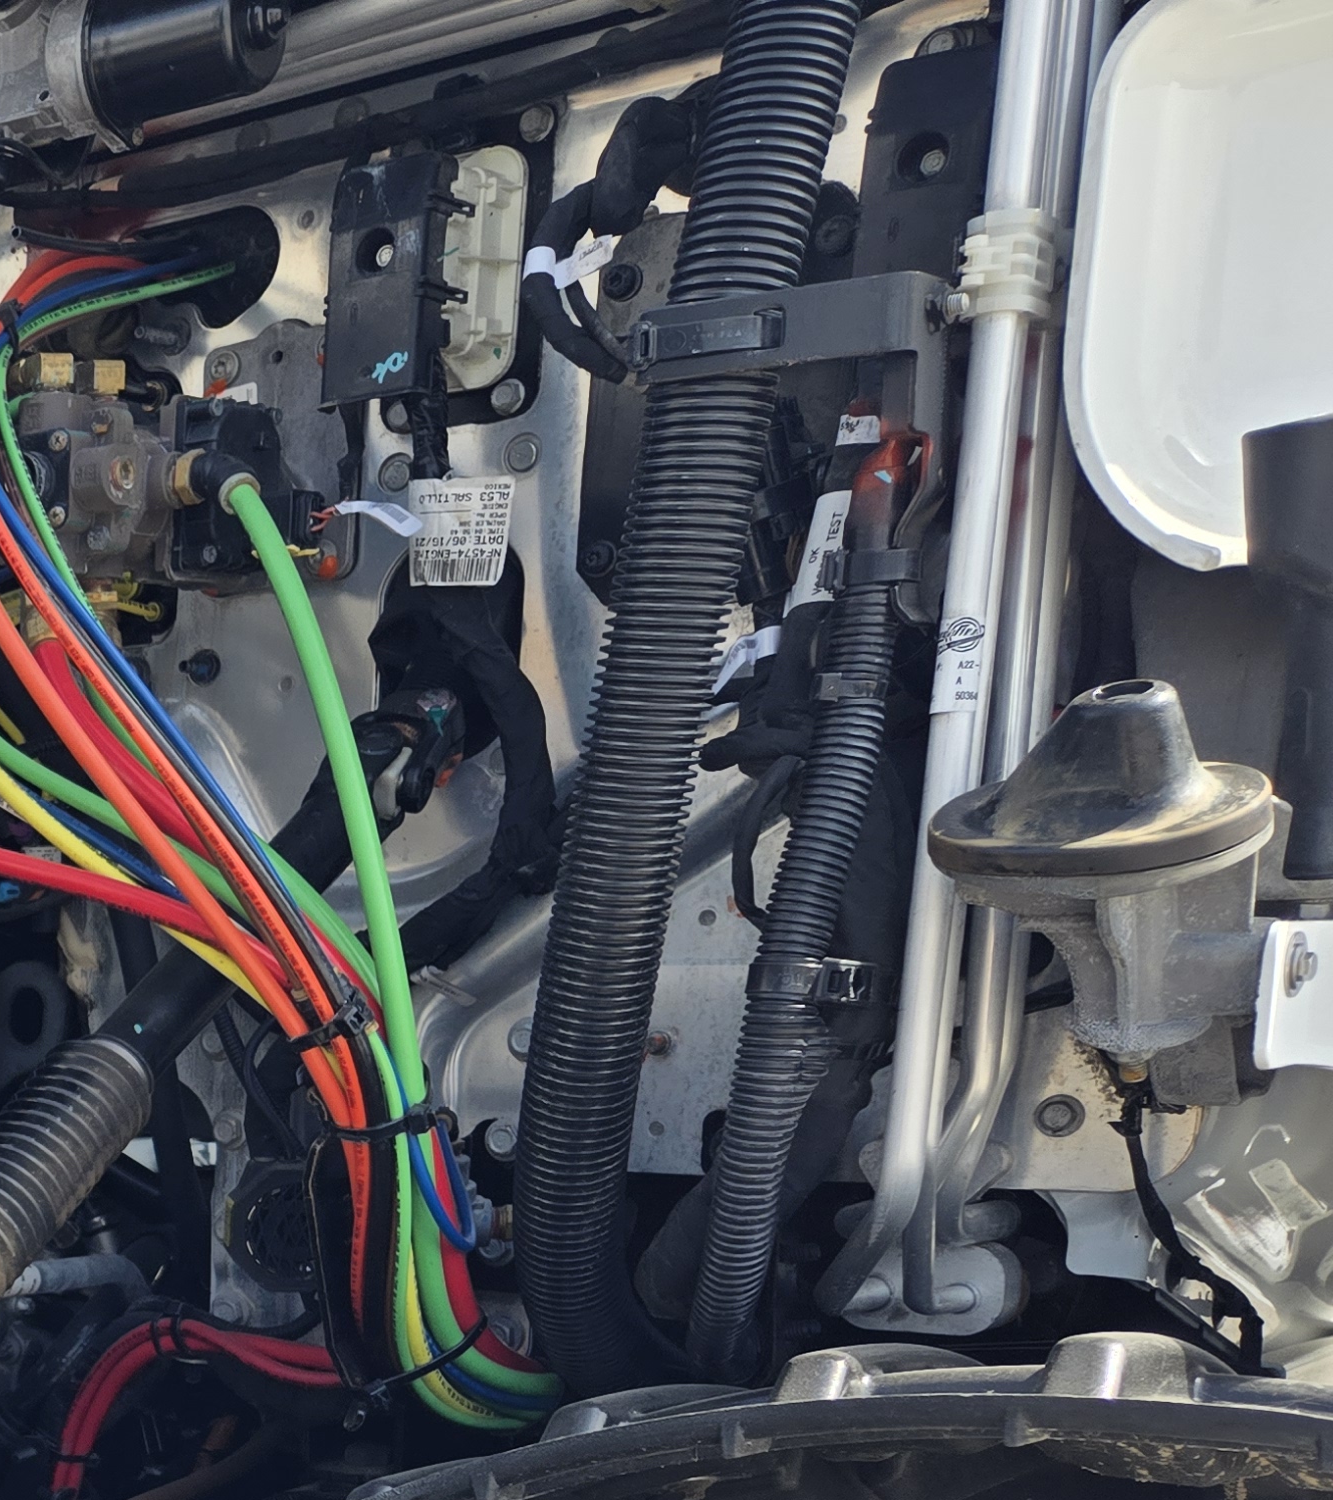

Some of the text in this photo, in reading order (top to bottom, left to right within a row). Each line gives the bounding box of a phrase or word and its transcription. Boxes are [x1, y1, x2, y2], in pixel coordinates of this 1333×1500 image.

[480, 491, 511, 502] AL53
[826, 511, 844, 542] TEST
[955, 676, 962, 685] A
